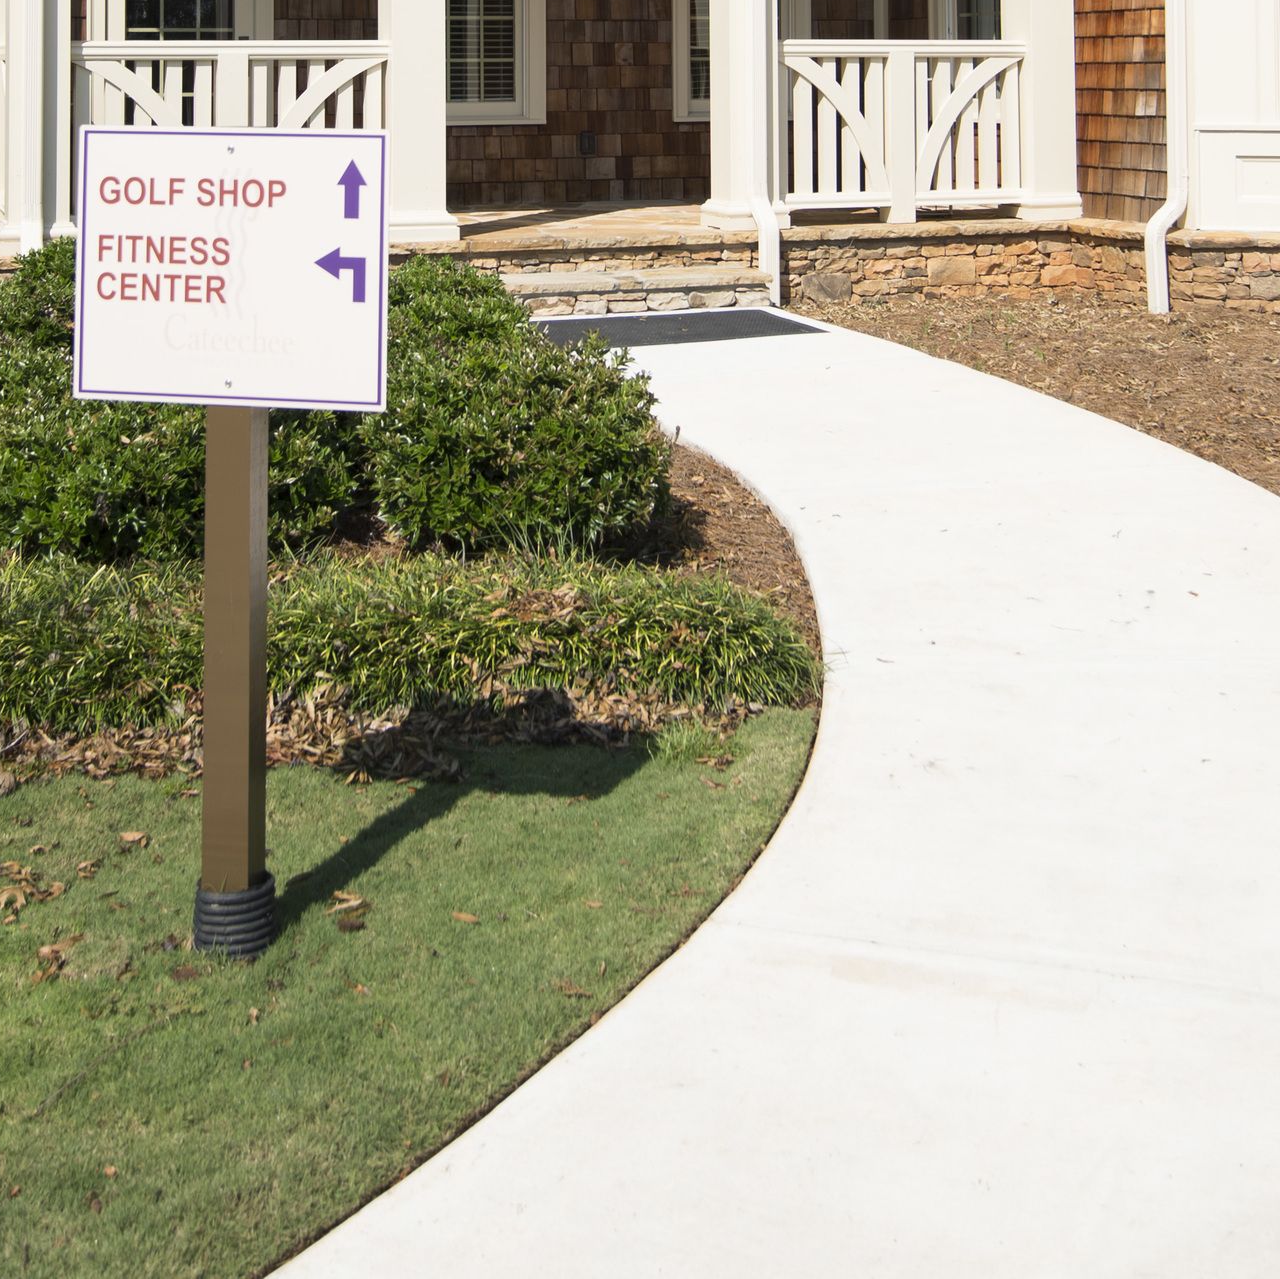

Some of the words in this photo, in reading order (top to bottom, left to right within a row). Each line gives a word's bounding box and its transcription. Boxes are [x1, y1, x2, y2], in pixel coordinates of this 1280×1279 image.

[98, 175, 186, 206] GOLF
[196, 177, 287, 208] SHOP
[97, 234, 231, 266] FITNESS
[96, 272, 227, 304] CENTER
